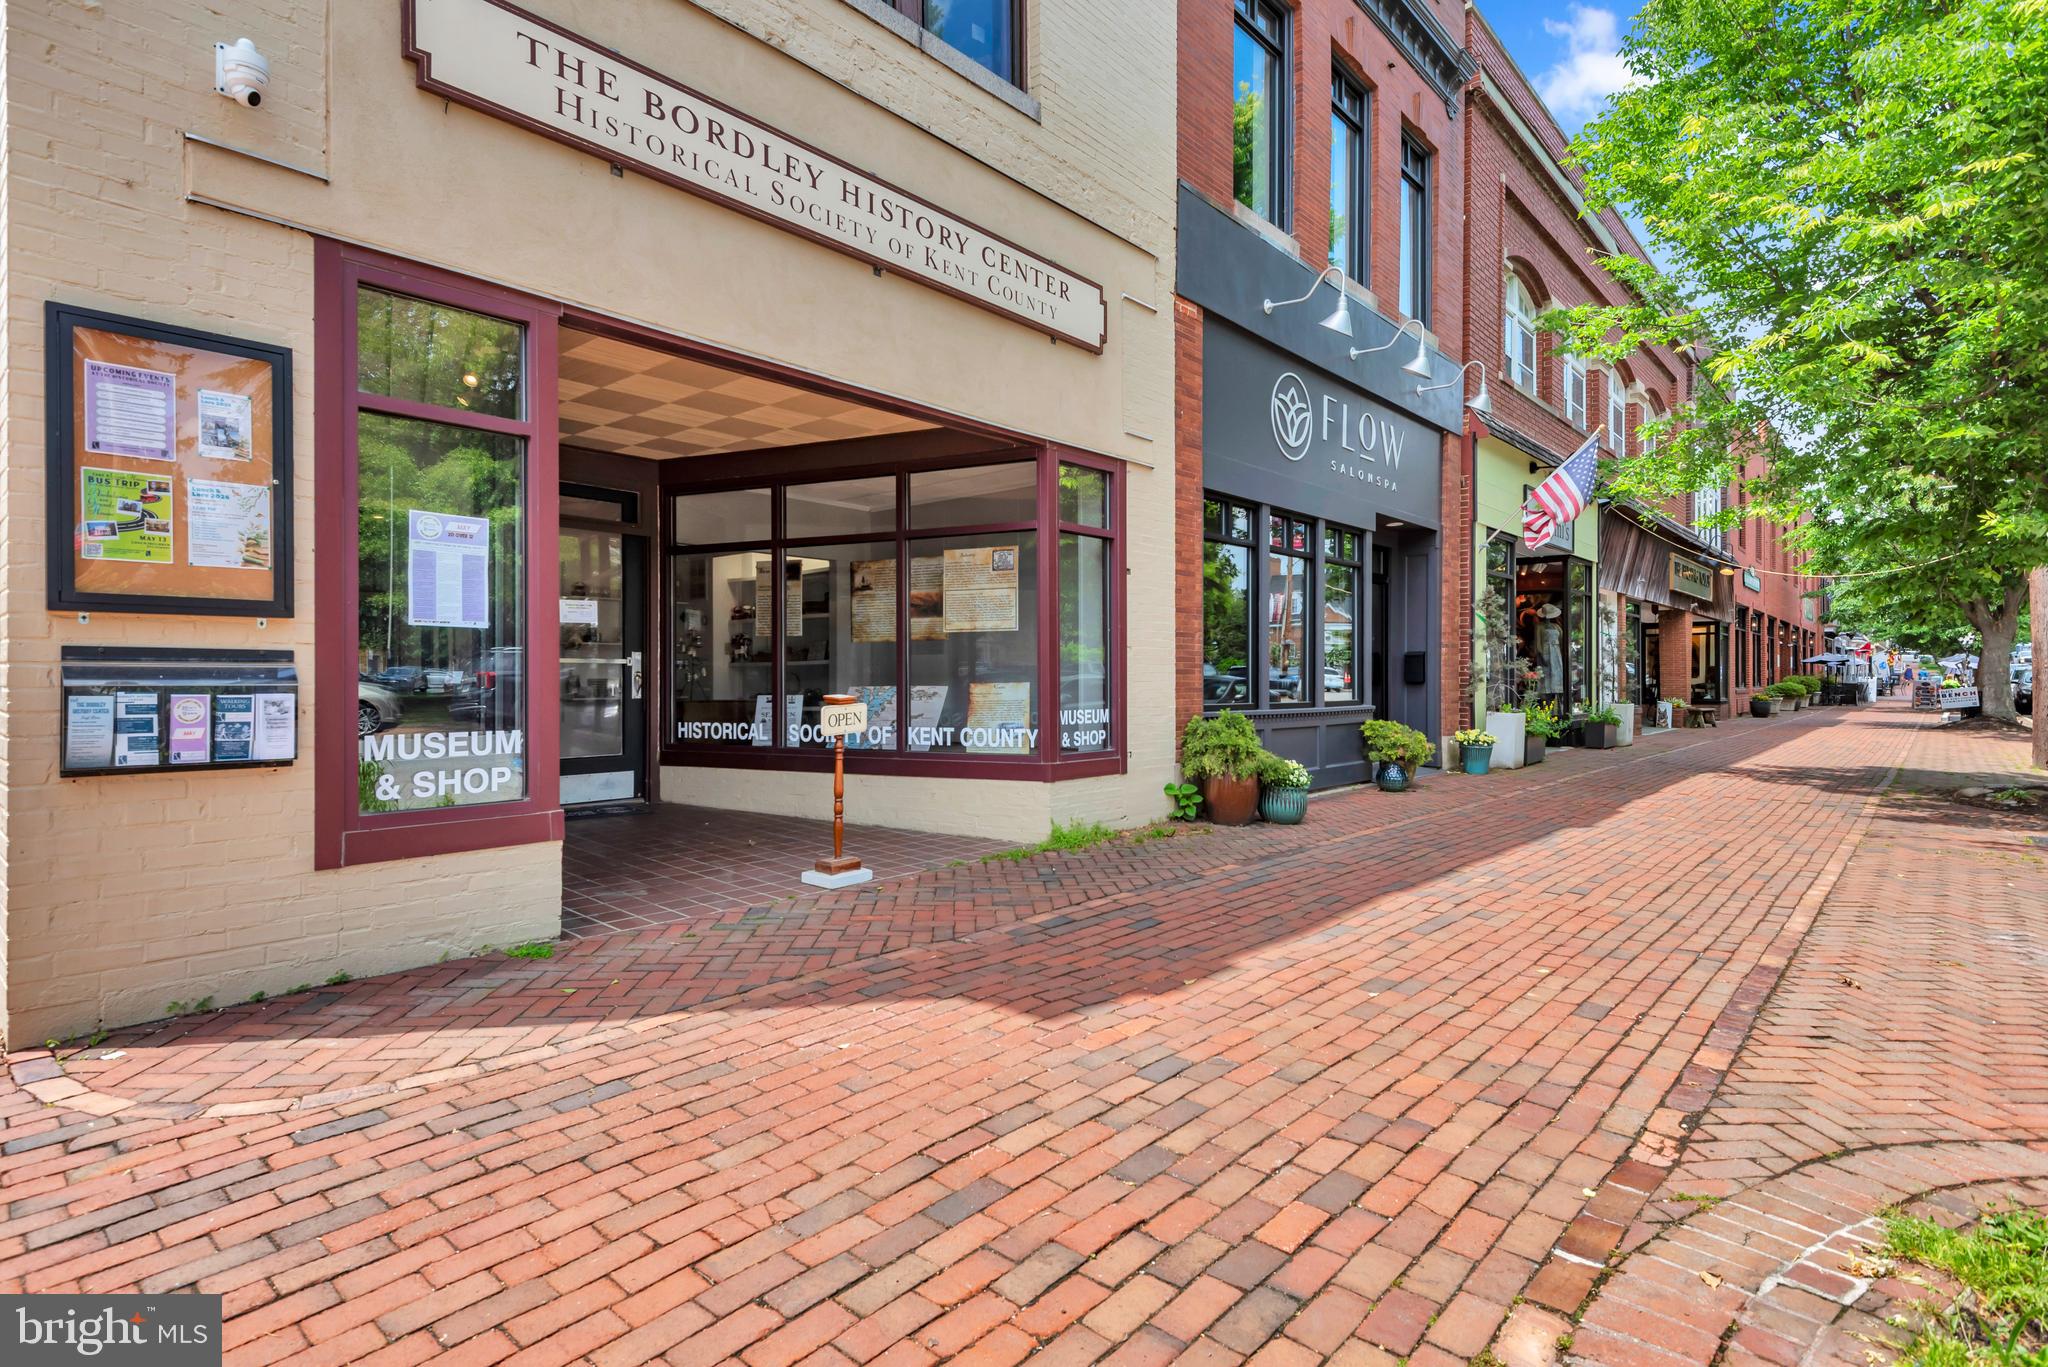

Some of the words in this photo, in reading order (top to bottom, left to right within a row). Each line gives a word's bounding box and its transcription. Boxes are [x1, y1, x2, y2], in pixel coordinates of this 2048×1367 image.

[516, 31, 620, 103] THE
[642, 88, 825, 190] BORDLEY
[840, 178, 969, 255] HISTORY
[982, 246, 1071, 302] CENTER
[554, 86, 758, 197] HISTORICAL
[770, 180, 878, 245] SOCIETY
[924, 246, 979, 286] KENT
[987, 275, 1058, 319] COUNTY
[90, 365, 137, 378] UPCOMING
[138, 372, 170, 383] EVENTS
[1322, 394, 1405, 470] FLOW
[88, 476, 111, 485] BUS
[116, 480, 140, 488] TRIP
[1331, 460, 1398, 492] SALONSPA
[1941, 690, 1976, 698] BENCH
[828, 711, 863, 728] OPEN
[1060, 709, 1109, 725] MUSEUM
[363, 730, 521, 761] MUSEUM
[677, 721, 768, 740] HISTORICAL
[868, 726, 893, 744] OF
[907, 726, 955, 746] KENT
[960, 727, 1039, 748] COUNTY
[1062, 732, 1071, 747] &
[1073, 730, 1106, 746] SHOP
[375, 773, 401, 801] &
[412, 766, 512, 798] SHOP
